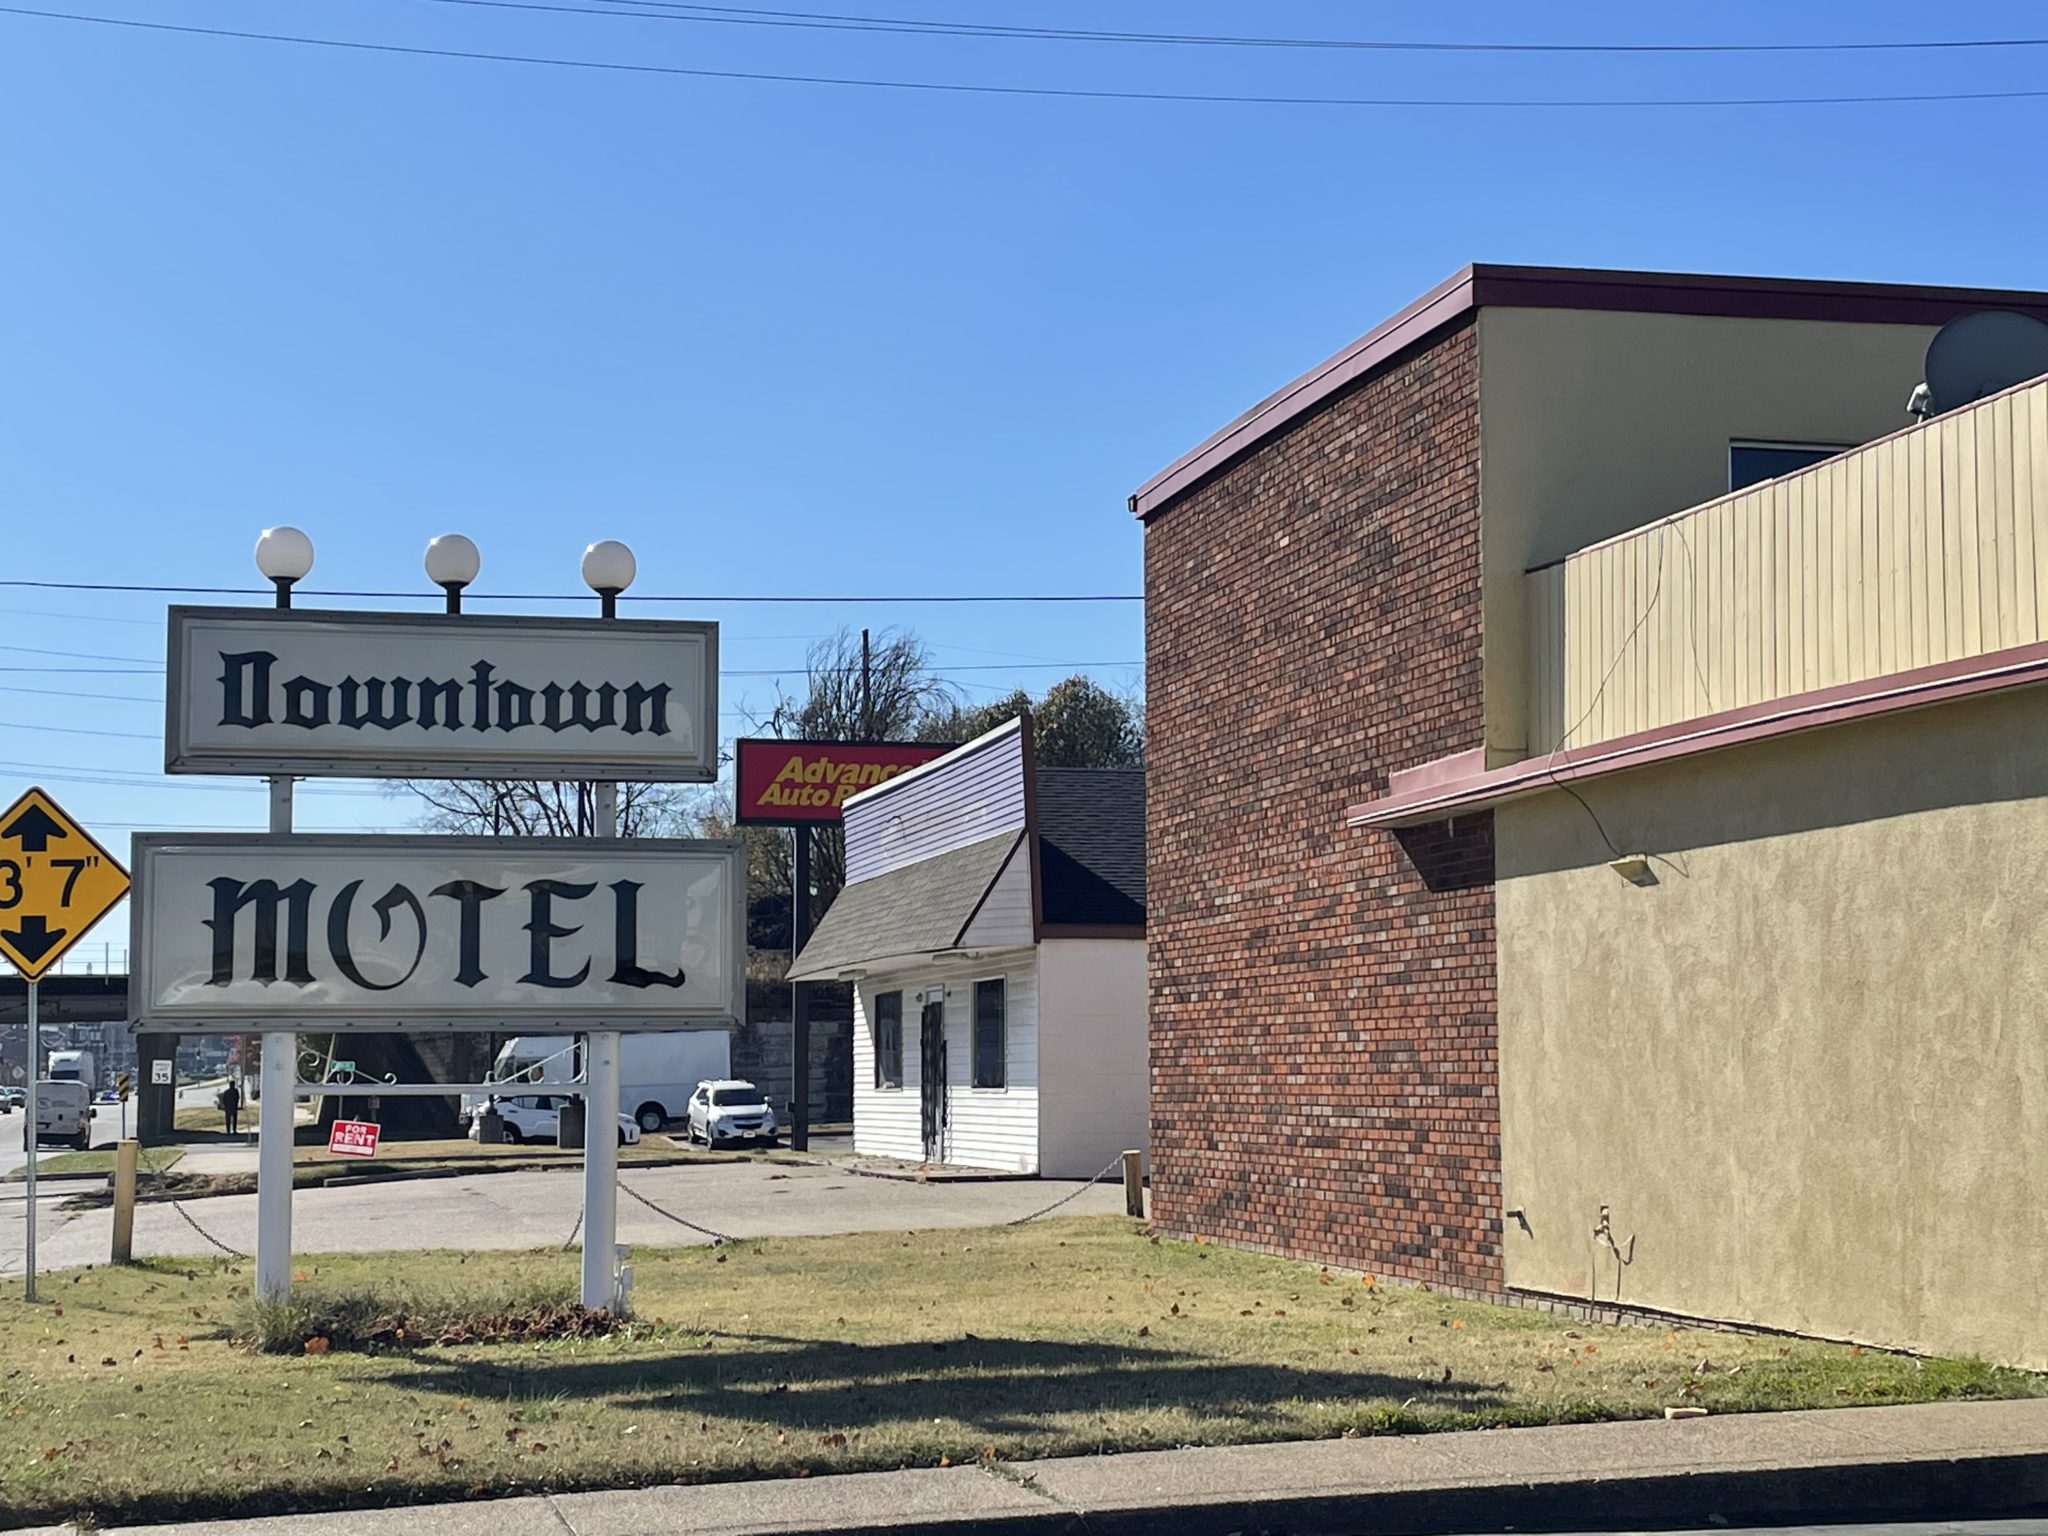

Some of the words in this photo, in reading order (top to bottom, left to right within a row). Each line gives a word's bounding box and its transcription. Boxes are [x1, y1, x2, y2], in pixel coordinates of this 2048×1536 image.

[216, 650, 673, 736] Downtown
[756, 784, 830, 806] Auto
[50, 856, 99, 908] 7"
[201, 876, 687, 991] MOTEL
[154, 1072, 169, 1082] 35
[334, 1132, 375, 1146] RENT
[345, 1124, 367, 1134] FOR
